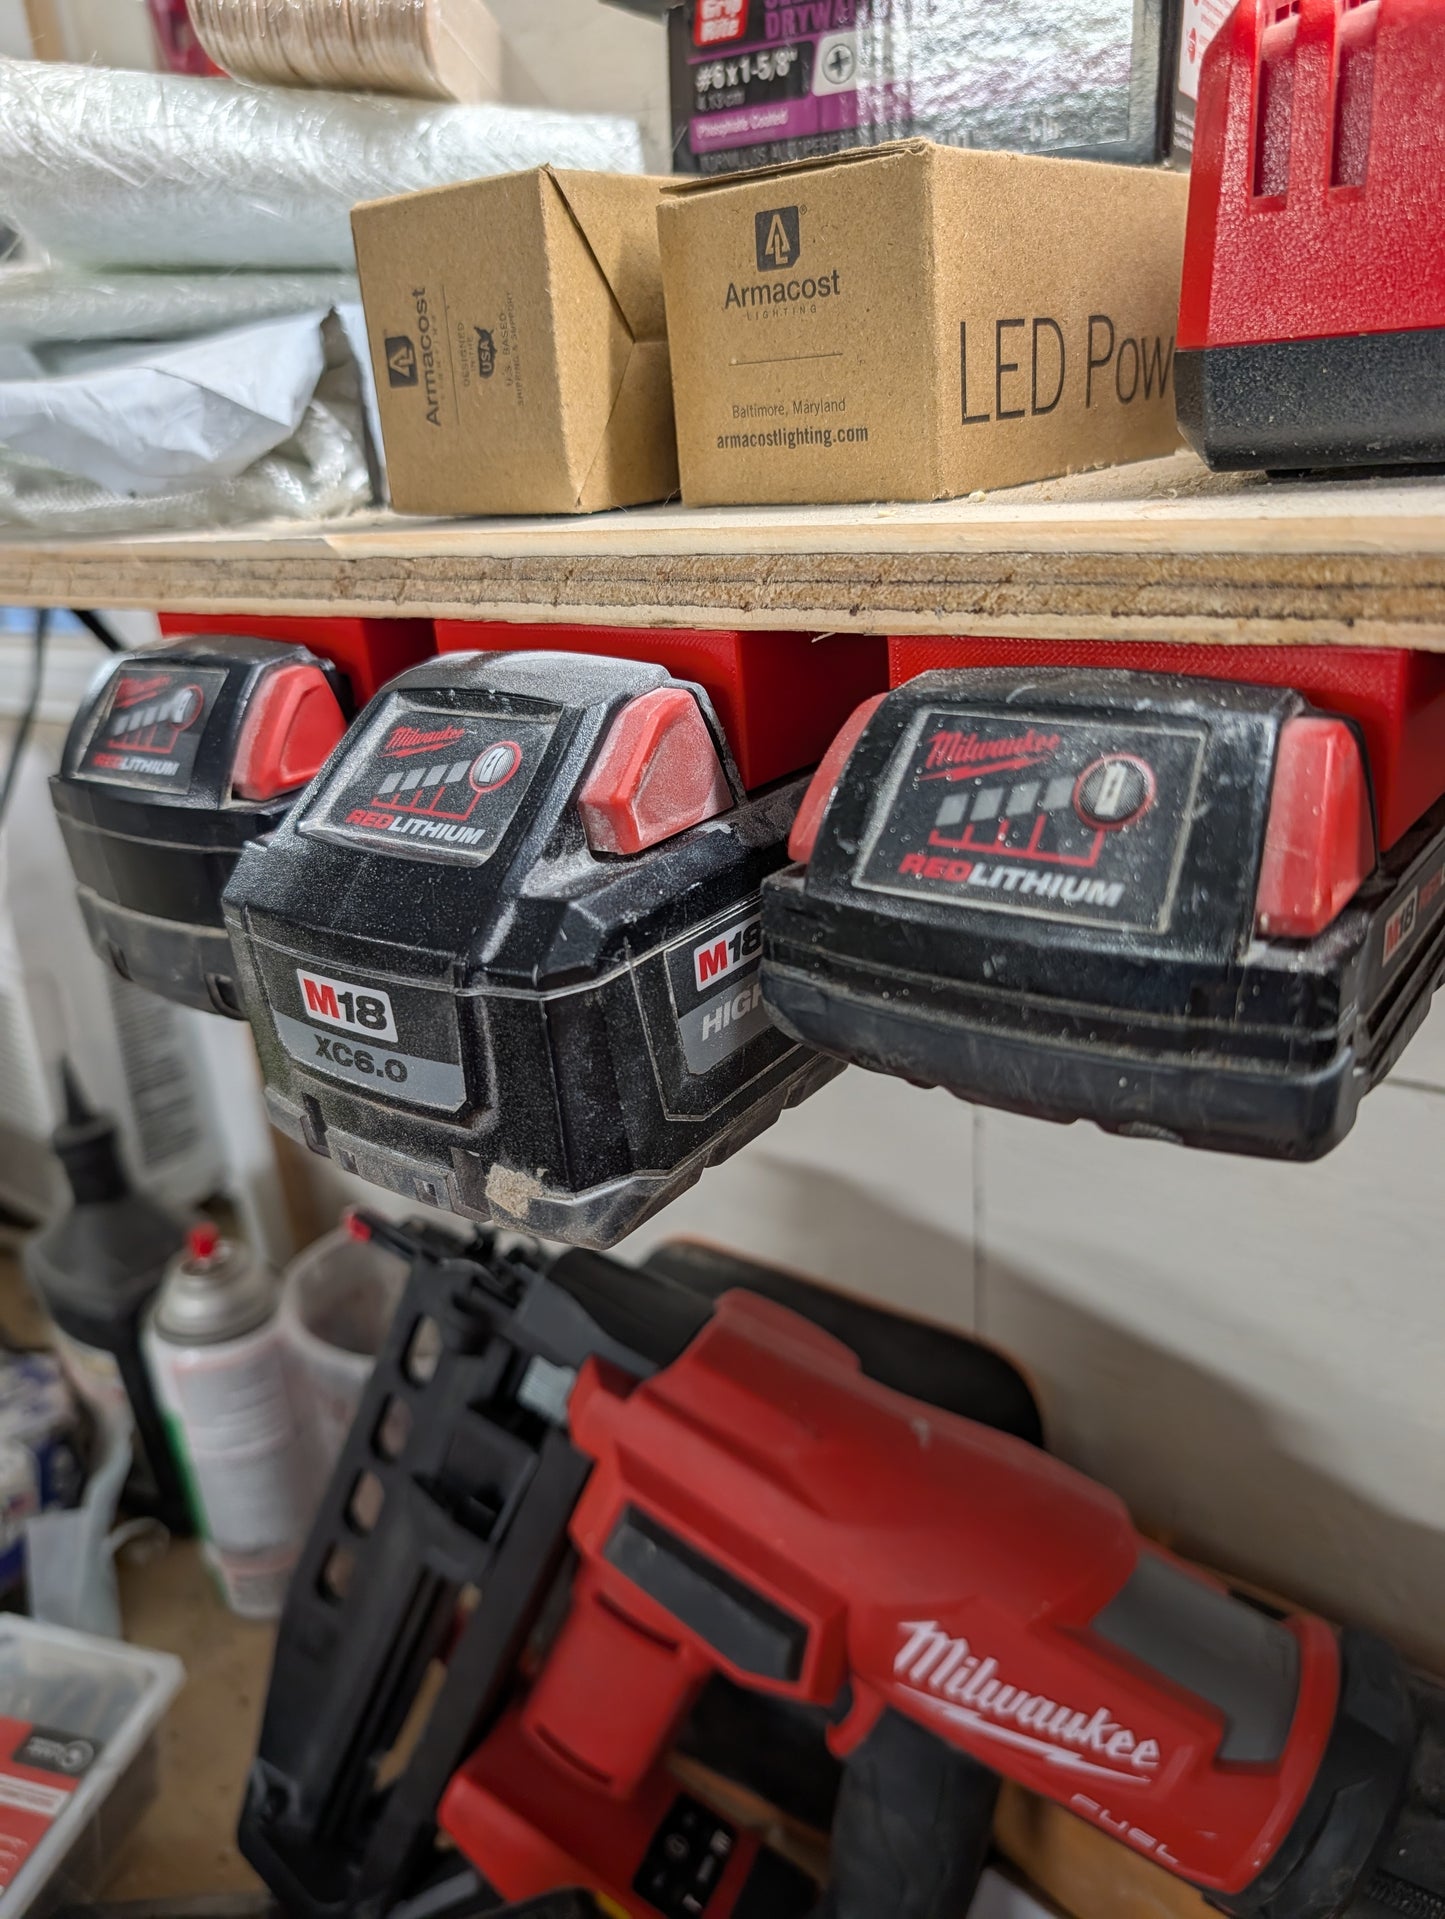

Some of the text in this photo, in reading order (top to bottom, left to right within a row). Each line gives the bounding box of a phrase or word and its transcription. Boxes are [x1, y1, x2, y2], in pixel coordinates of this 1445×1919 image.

[725, 269, 841, 309] Armacost
[746, 304, 817, 321] LIGHTING
[411, 287, 442, 427] Armacost
[479, 340, 493, 373] USA
[960, 318, 1066, 426] LED
[732, 399, 846, 419] Baltimore, Maryland
[717, 426, 868, 449] armacostlighting.com
[386, 725, 466, 750] Milwaukee
[925, 728, 1061, 769] Milwaukee
[345, 809, 485, 845] REDLITHIUM
[899, 853, 1126, 908] REDLITHIUM
[698, 919, 761, 983] M18
[303, 978, 388, 1031] M18
[314, 1033, 408, 1083] XC6.0
[893, 1619, 1161, 1769] Milwaukee
